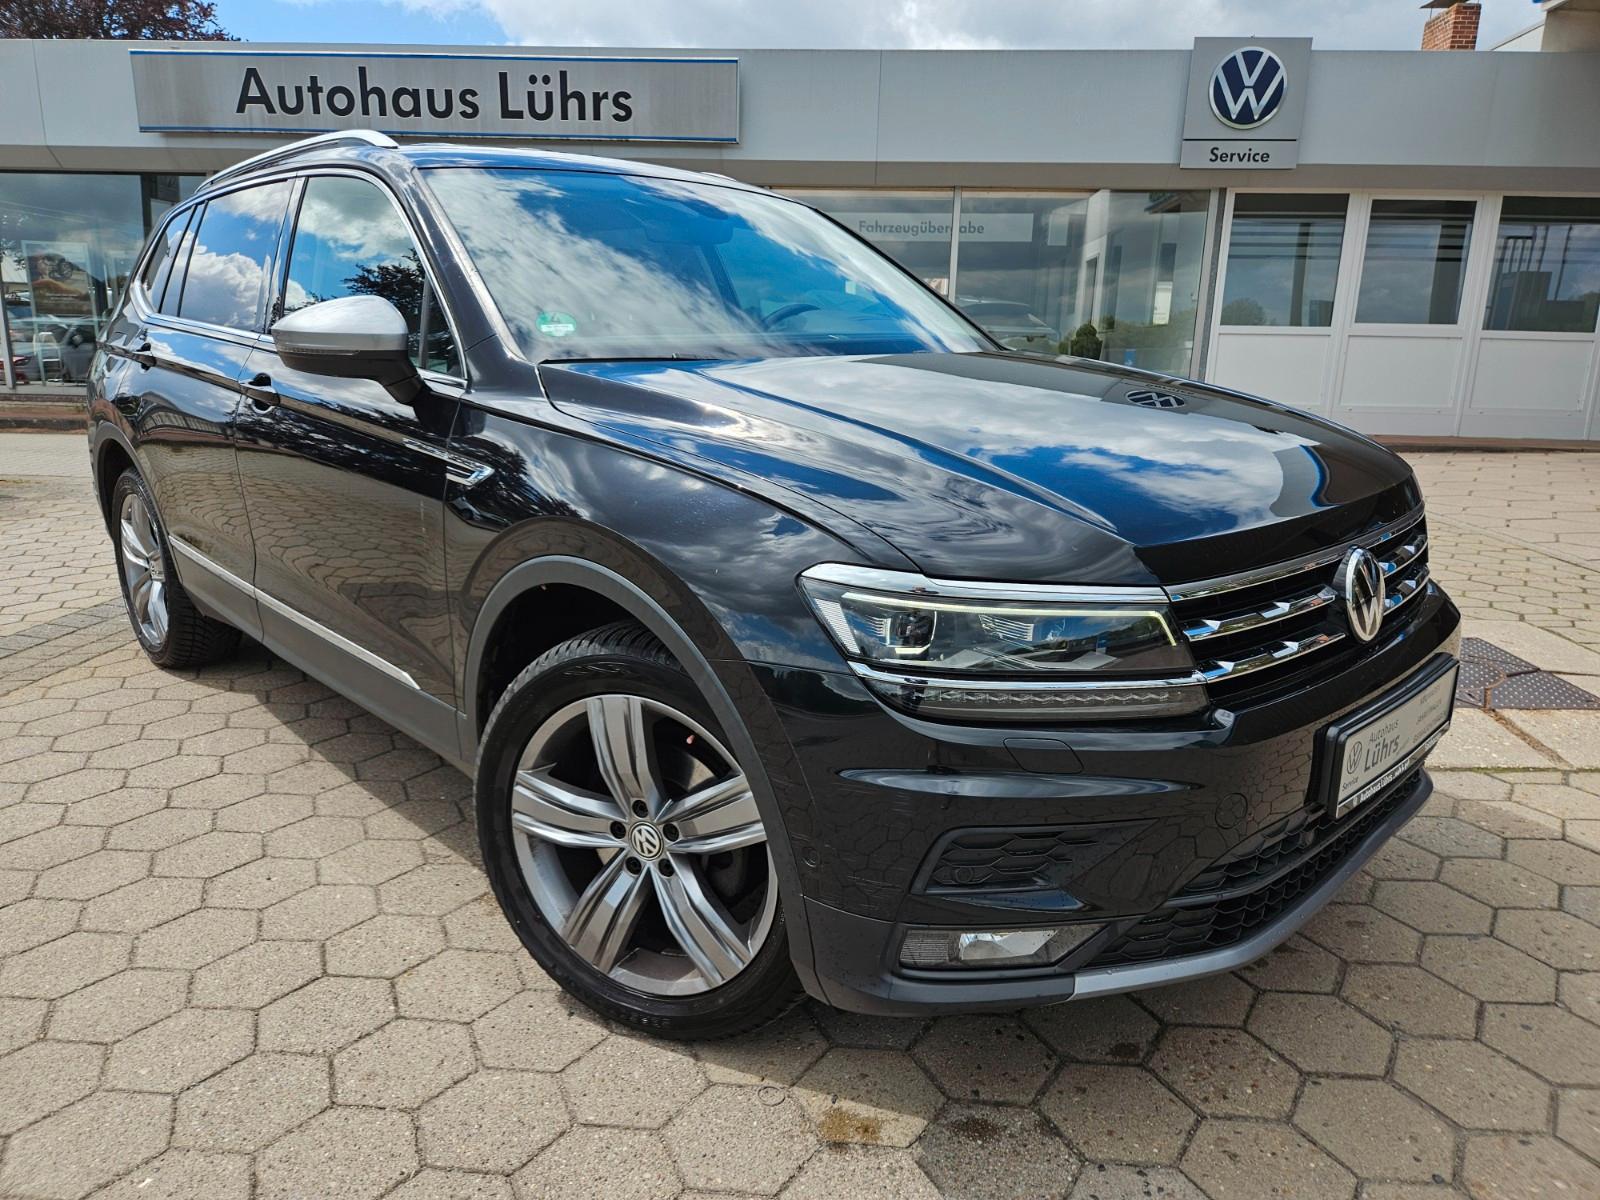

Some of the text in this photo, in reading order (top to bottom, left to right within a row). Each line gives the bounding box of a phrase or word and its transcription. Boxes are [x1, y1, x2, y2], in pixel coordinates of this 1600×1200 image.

[235, 66, 633, 123] Autohaus Lührs
[1209, 146, 1270, 163] Service
[858, 220, 985, 236] Fahrzeugüberabe
[1369, 720, 1400, 742] Autohaus
[1364, 735, 1400, 772] Lührs
